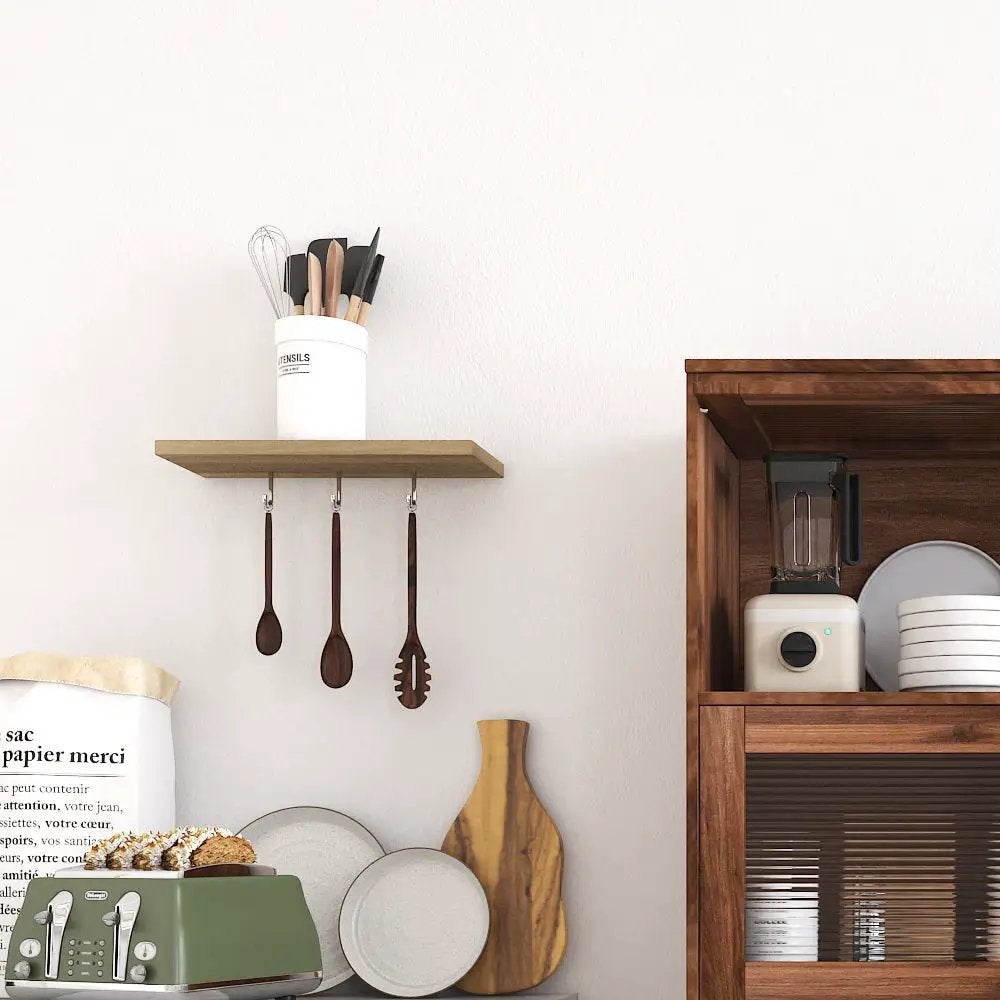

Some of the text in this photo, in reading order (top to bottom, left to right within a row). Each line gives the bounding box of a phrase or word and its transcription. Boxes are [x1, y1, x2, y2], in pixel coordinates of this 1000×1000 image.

[5, 730, 34, 742] sac
[2, 745, 125, 768] papier merci
[12, 784, 36, 797] peut
[39, 783, 90, 794] contenir
[64, 803, 94, 811] votre
[96, 801, 123, 815] jean,
[45, 820, 78, 829] votre
[41, 838, 61, 846] vos
[27, 855, 59, 864] votre
[61, 855, 86, 864] con
